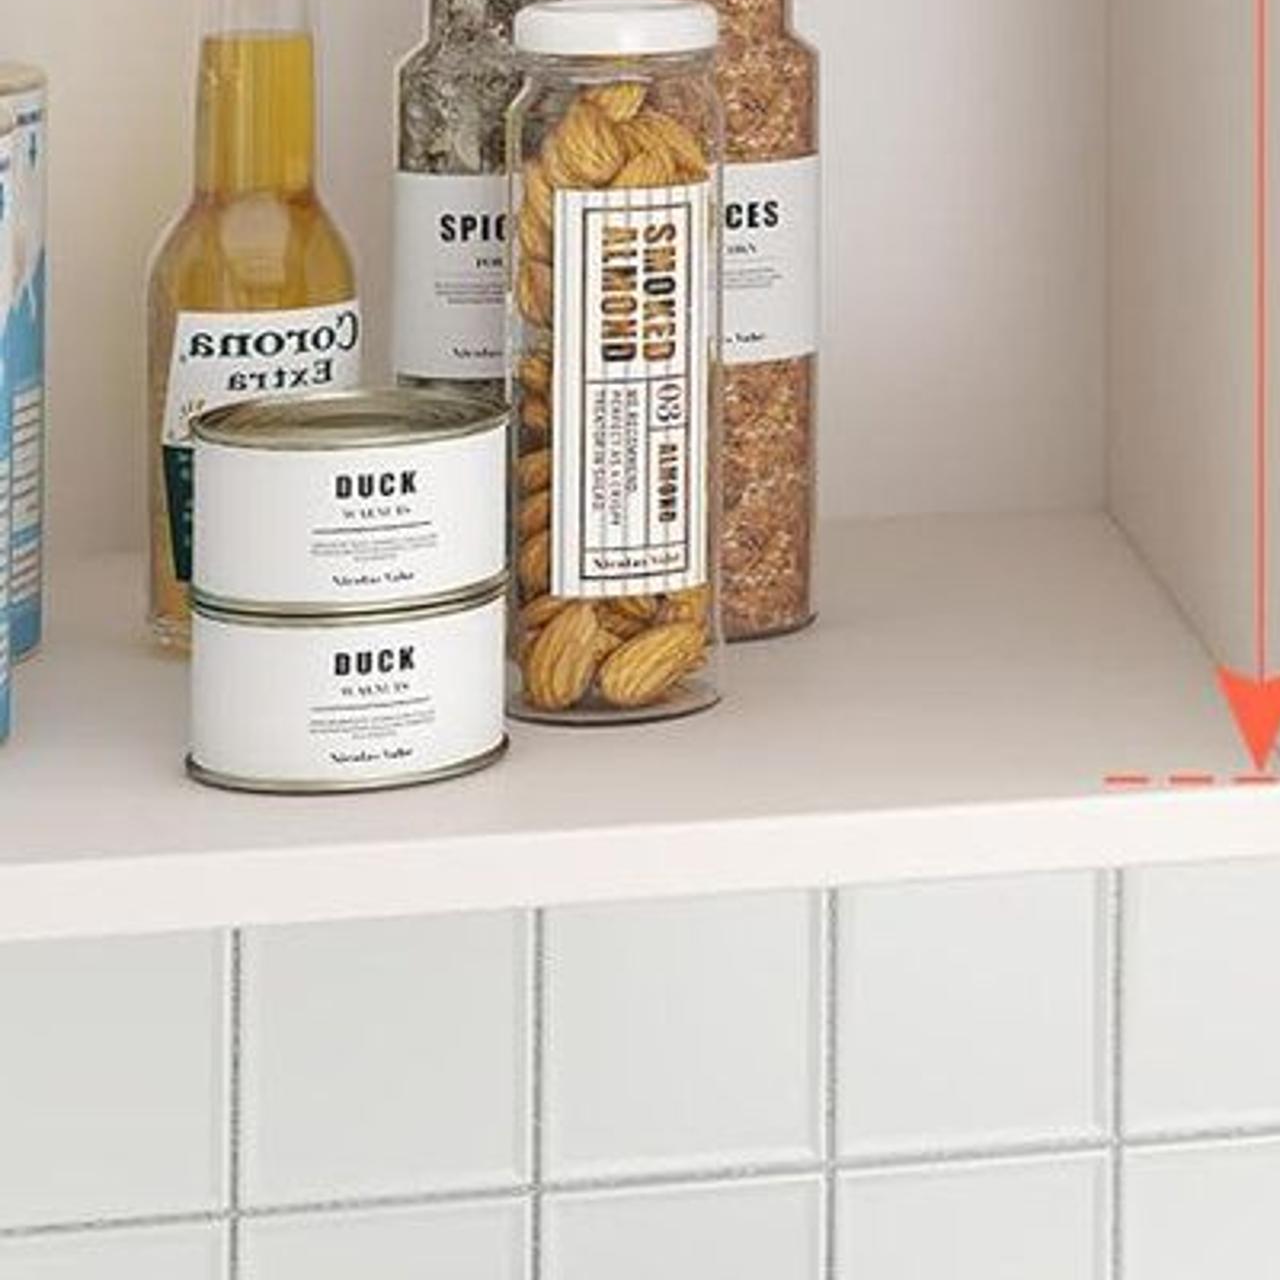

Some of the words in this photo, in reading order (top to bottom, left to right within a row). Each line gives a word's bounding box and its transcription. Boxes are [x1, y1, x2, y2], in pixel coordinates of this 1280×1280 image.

[725, 200, 780, 230] CES
[600, 224, 638, 365] ALMOND
[642, 220, 677, 364] SMOKED
[656, 382, 683, 424] 03
[335, 469, 417, 500] DUCK
[657, 442, 679, 524] ALMOND
[333, 644, 415, 677] DUCK
